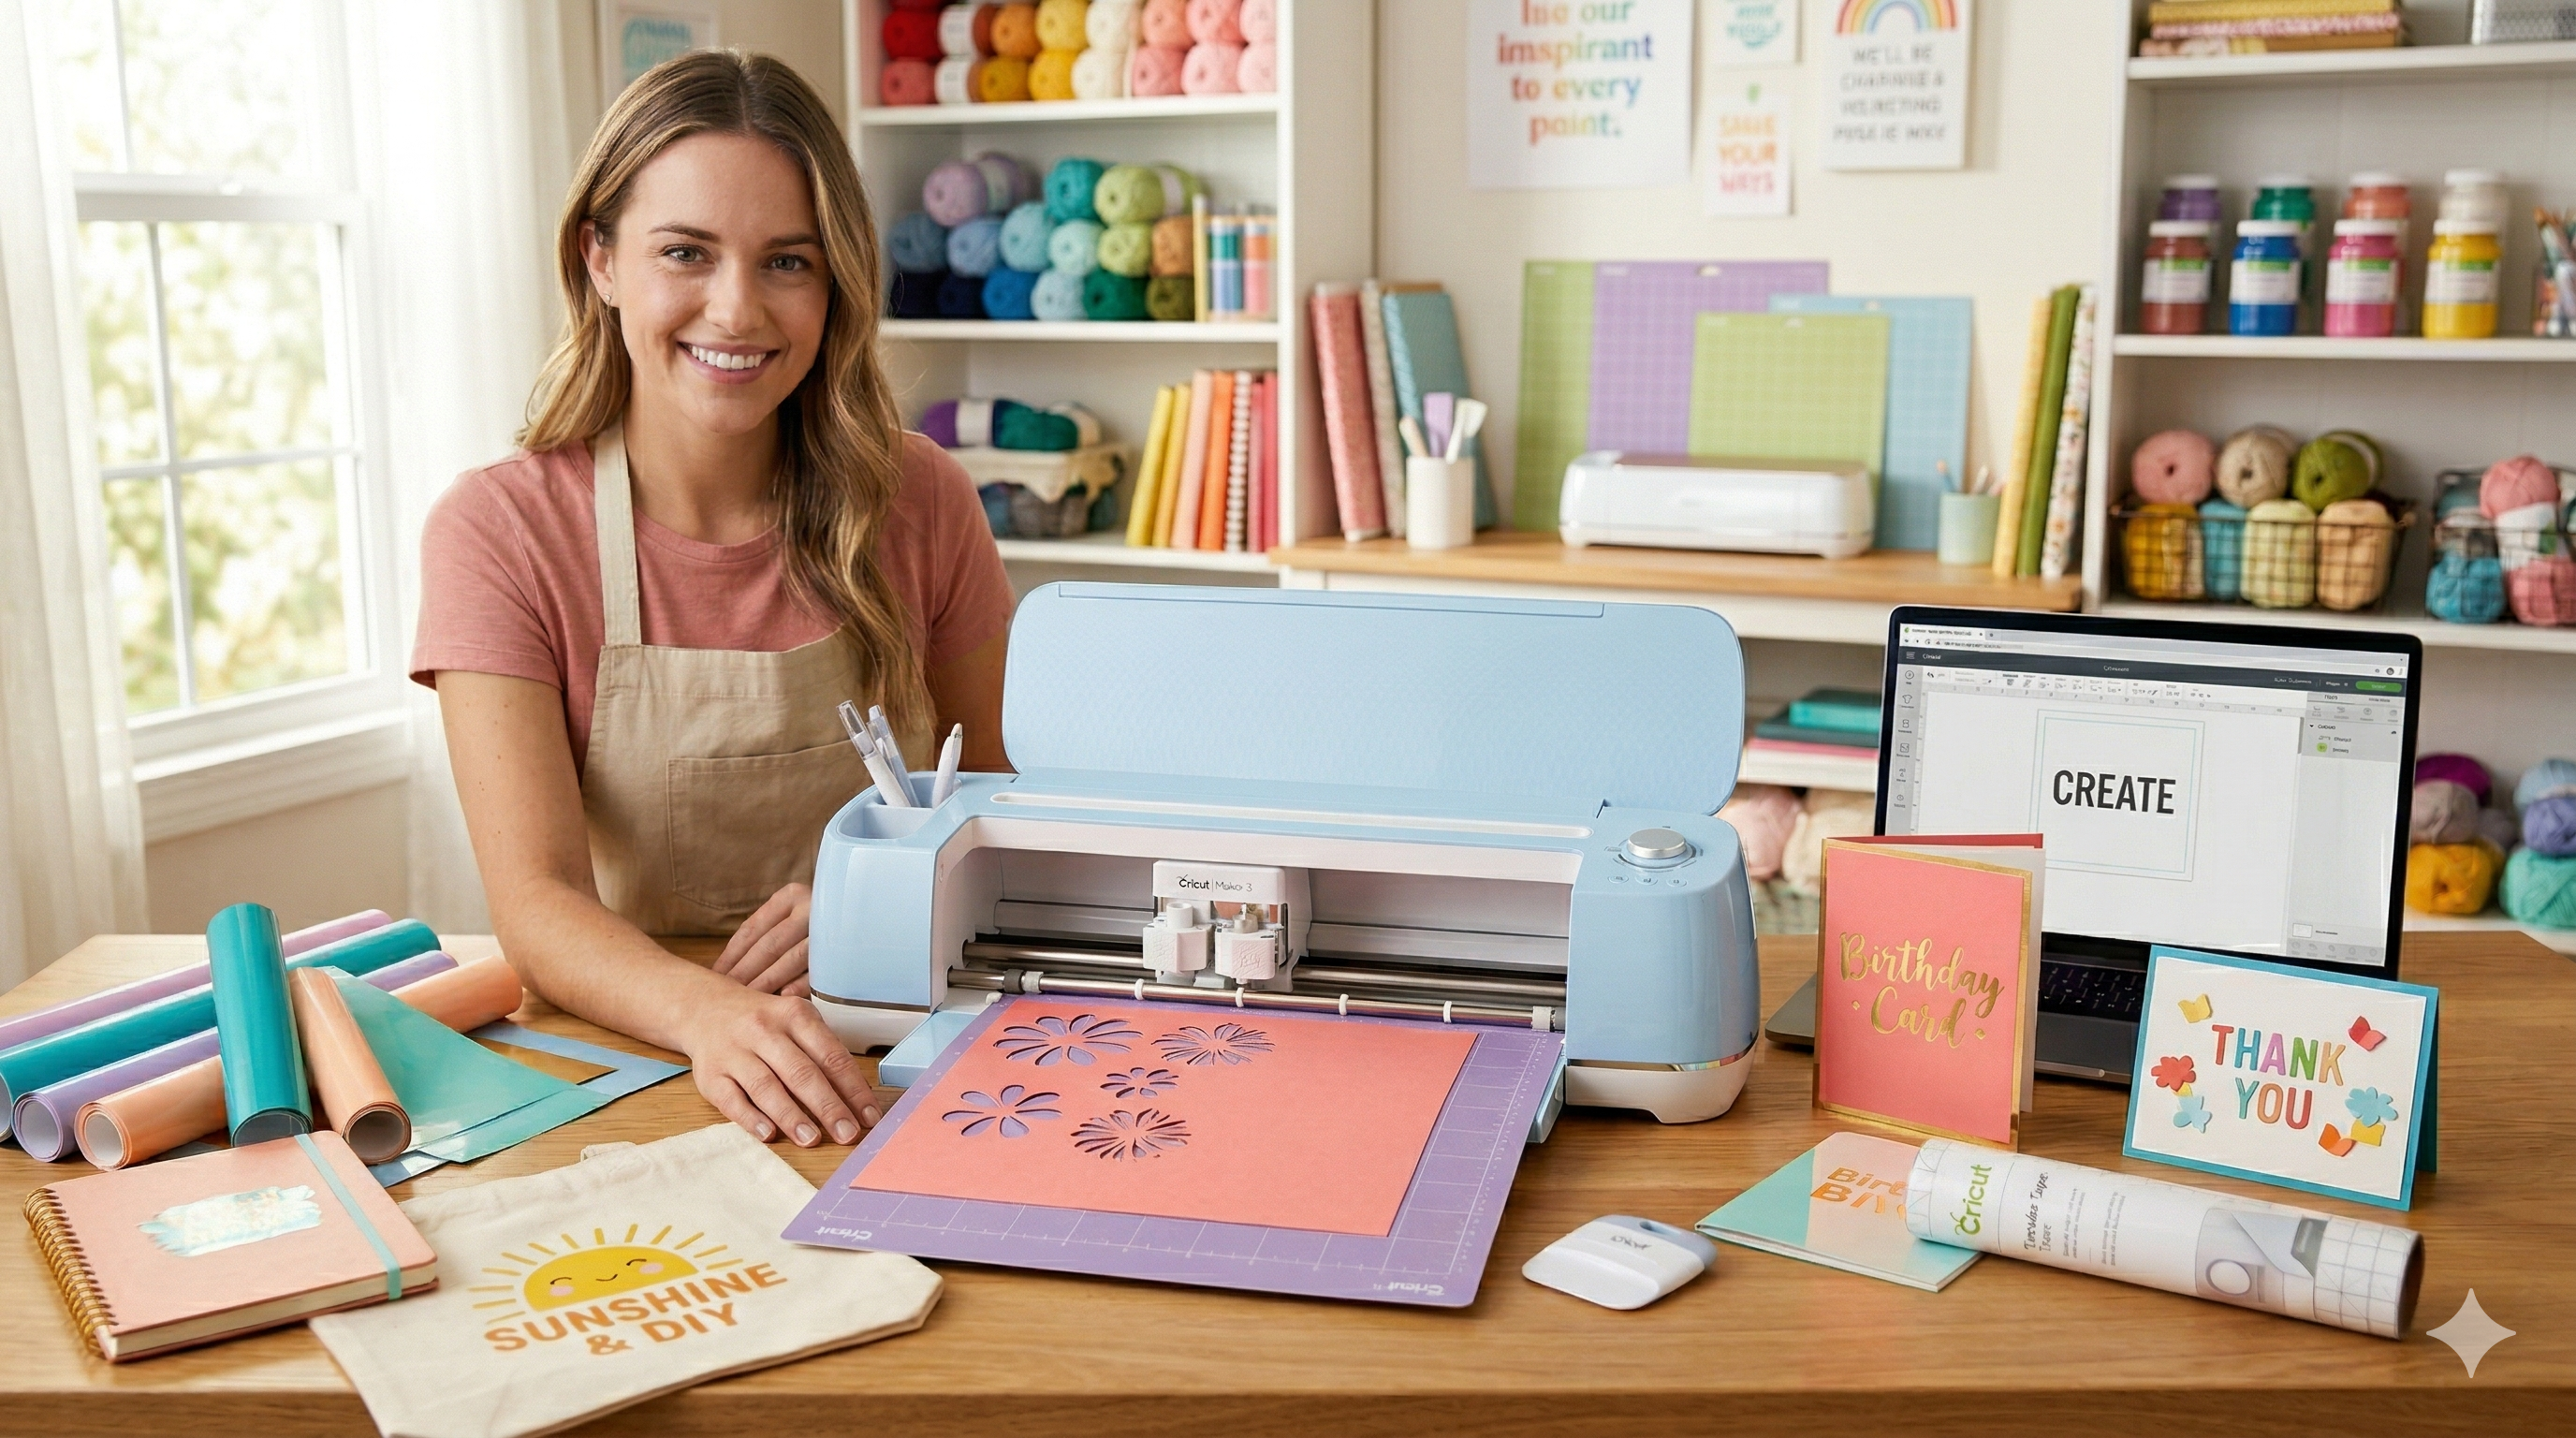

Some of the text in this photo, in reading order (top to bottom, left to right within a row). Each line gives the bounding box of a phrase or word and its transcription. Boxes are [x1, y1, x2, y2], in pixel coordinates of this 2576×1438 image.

[1581, 2, 1632, 24] our
[1512, 75, 1641, 110] to every
[2053, 770, 2176, 814] CREATE
[1177, 874, 1210, 890] Cricut
[1245, 882, 1253, 892] 3
[1840, 932, 2005, 1020] Birthday
[1871, 986, 1967, 1049] Card
[2212, 1023, 2347, 1087] THANK
[2234, 1077, 2313, 1130] YOU
[1951, 1164, 1993, 1236] Cricut
[484, 1262, 788, 1352] SUNSHINE
[586, 1301, 739, 1356] & DIY
